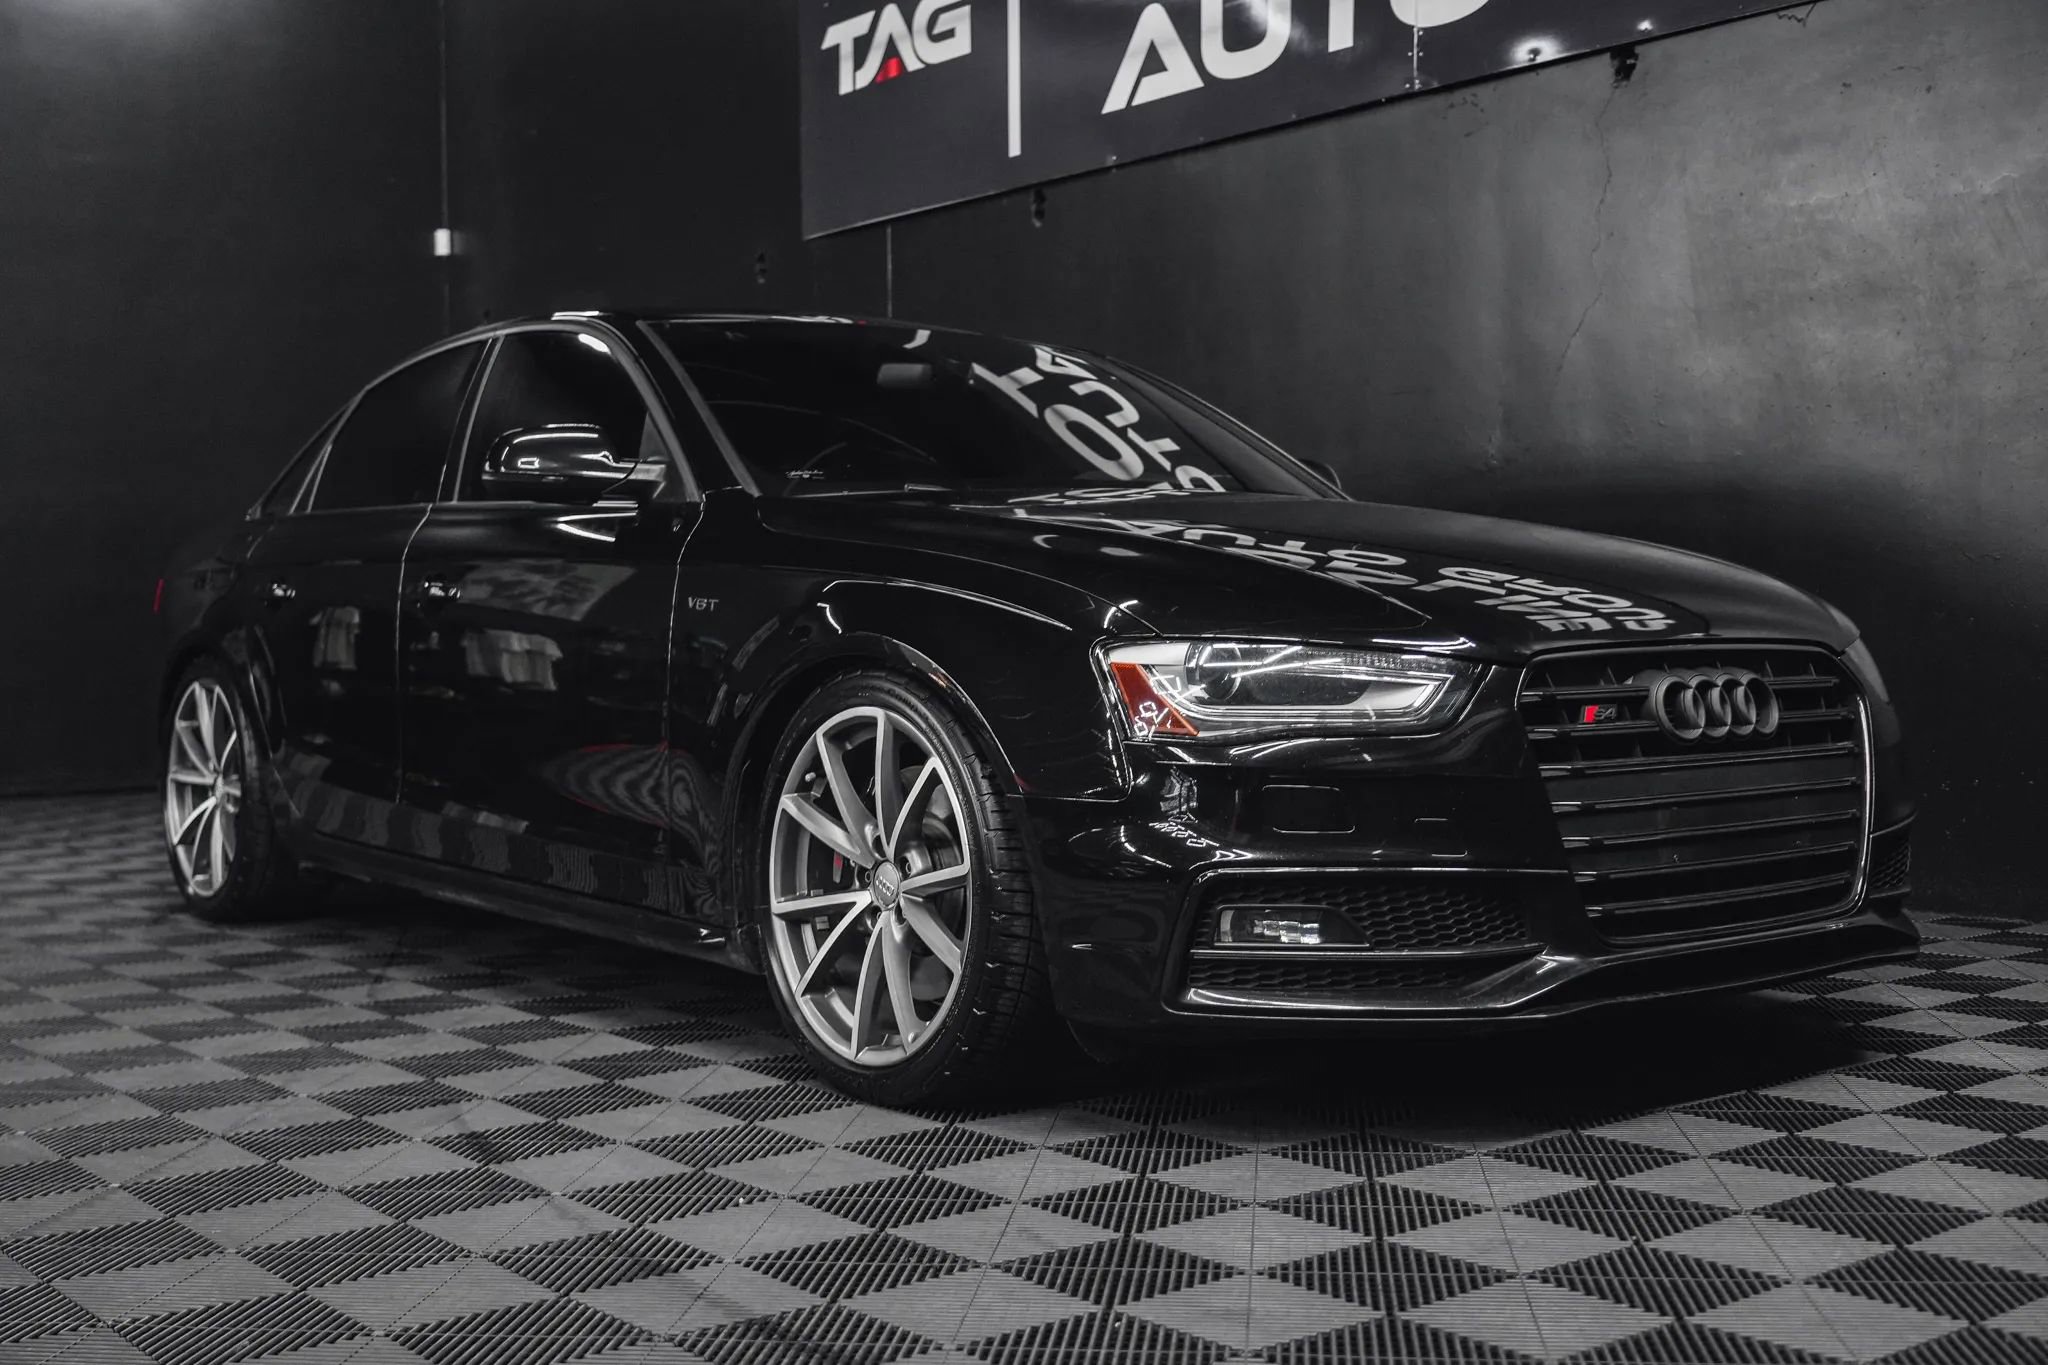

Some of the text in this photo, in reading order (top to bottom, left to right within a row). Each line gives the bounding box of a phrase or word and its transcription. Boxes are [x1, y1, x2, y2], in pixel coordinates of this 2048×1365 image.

[821, 0, 972, 96] TAG
[1101, 0, 1490, 115] AU
[687, 596, 720, 612] V6T
